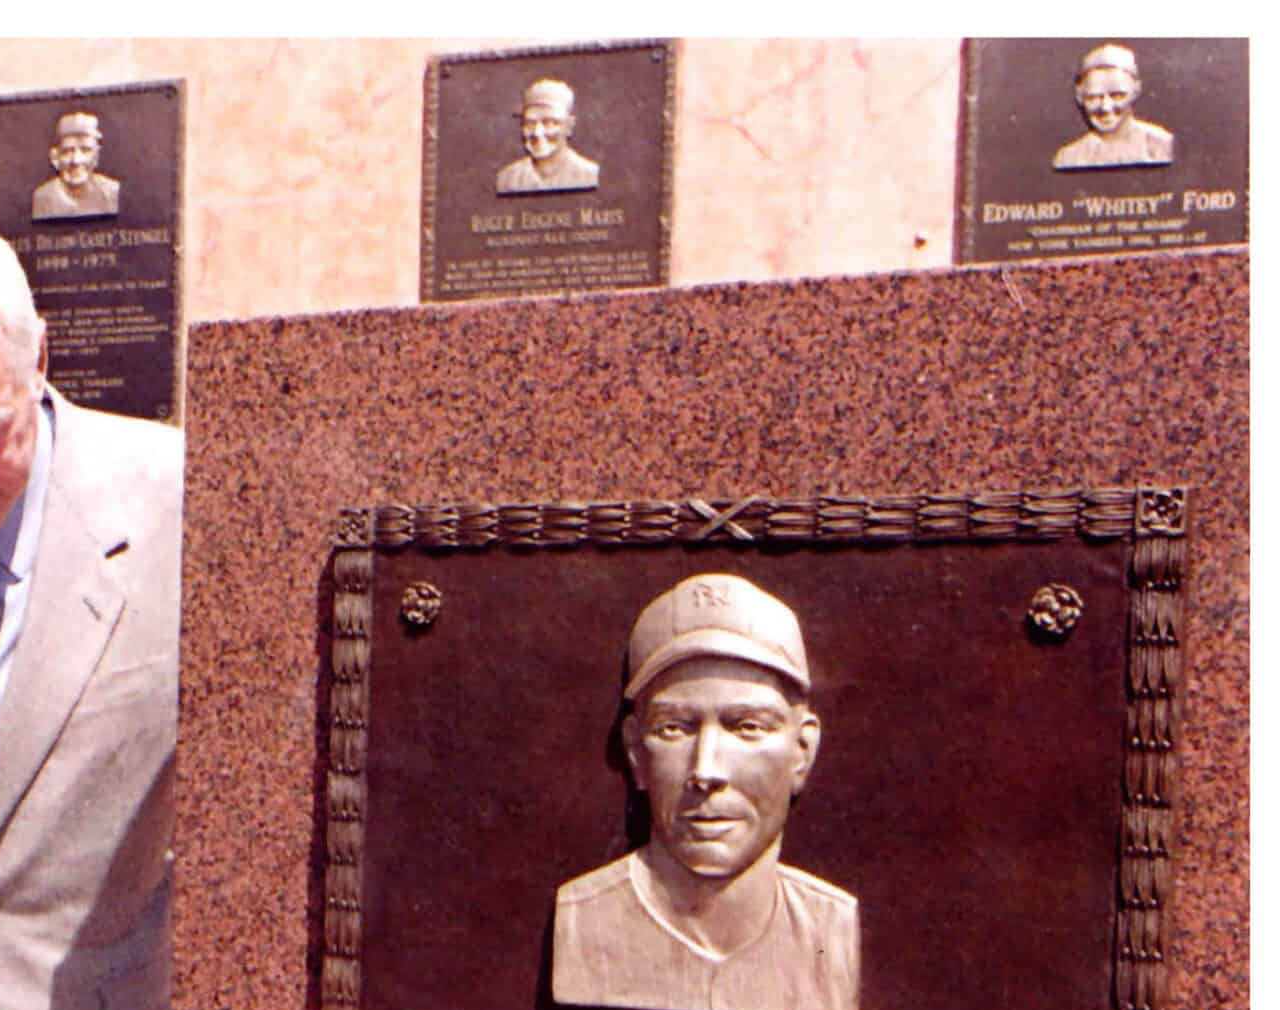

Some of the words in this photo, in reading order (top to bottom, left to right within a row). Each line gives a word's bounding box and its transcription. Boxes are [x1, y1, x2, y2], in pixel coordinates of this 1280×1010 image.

[580, 208, 624, 225] MARIS
[983, 203, 1063, 223] EDWARD
[1183, 191, 1235, 212] FORD
